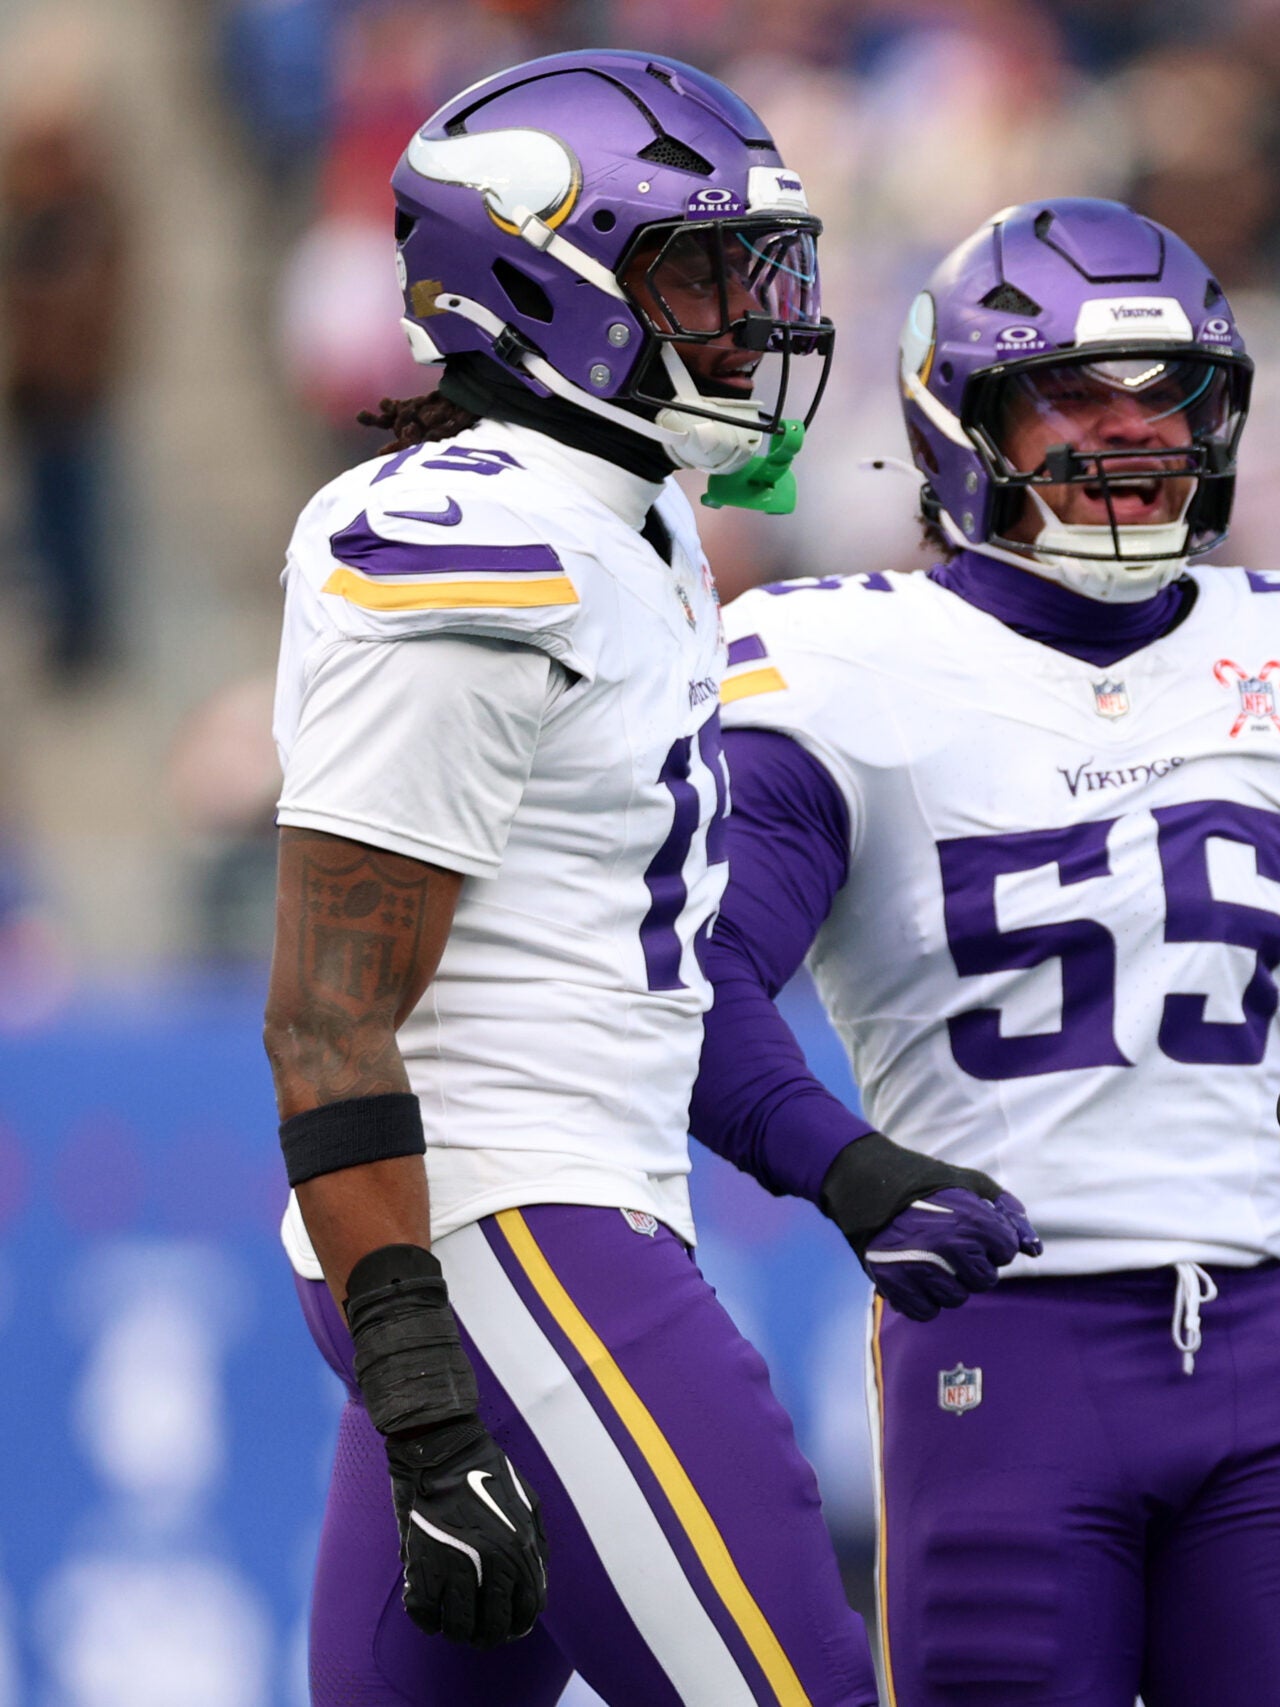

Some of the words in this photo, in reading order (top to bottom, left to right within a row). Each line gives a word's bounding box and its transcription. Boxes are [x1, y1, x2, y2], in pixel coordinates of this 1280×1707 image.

[688, 203, 740, 212] OAKLEY
[1098, 693, 1128, 713] NFL
[1244, 693, 1273, 713] NFL
[946, 1386, 975, 1406] NFL
